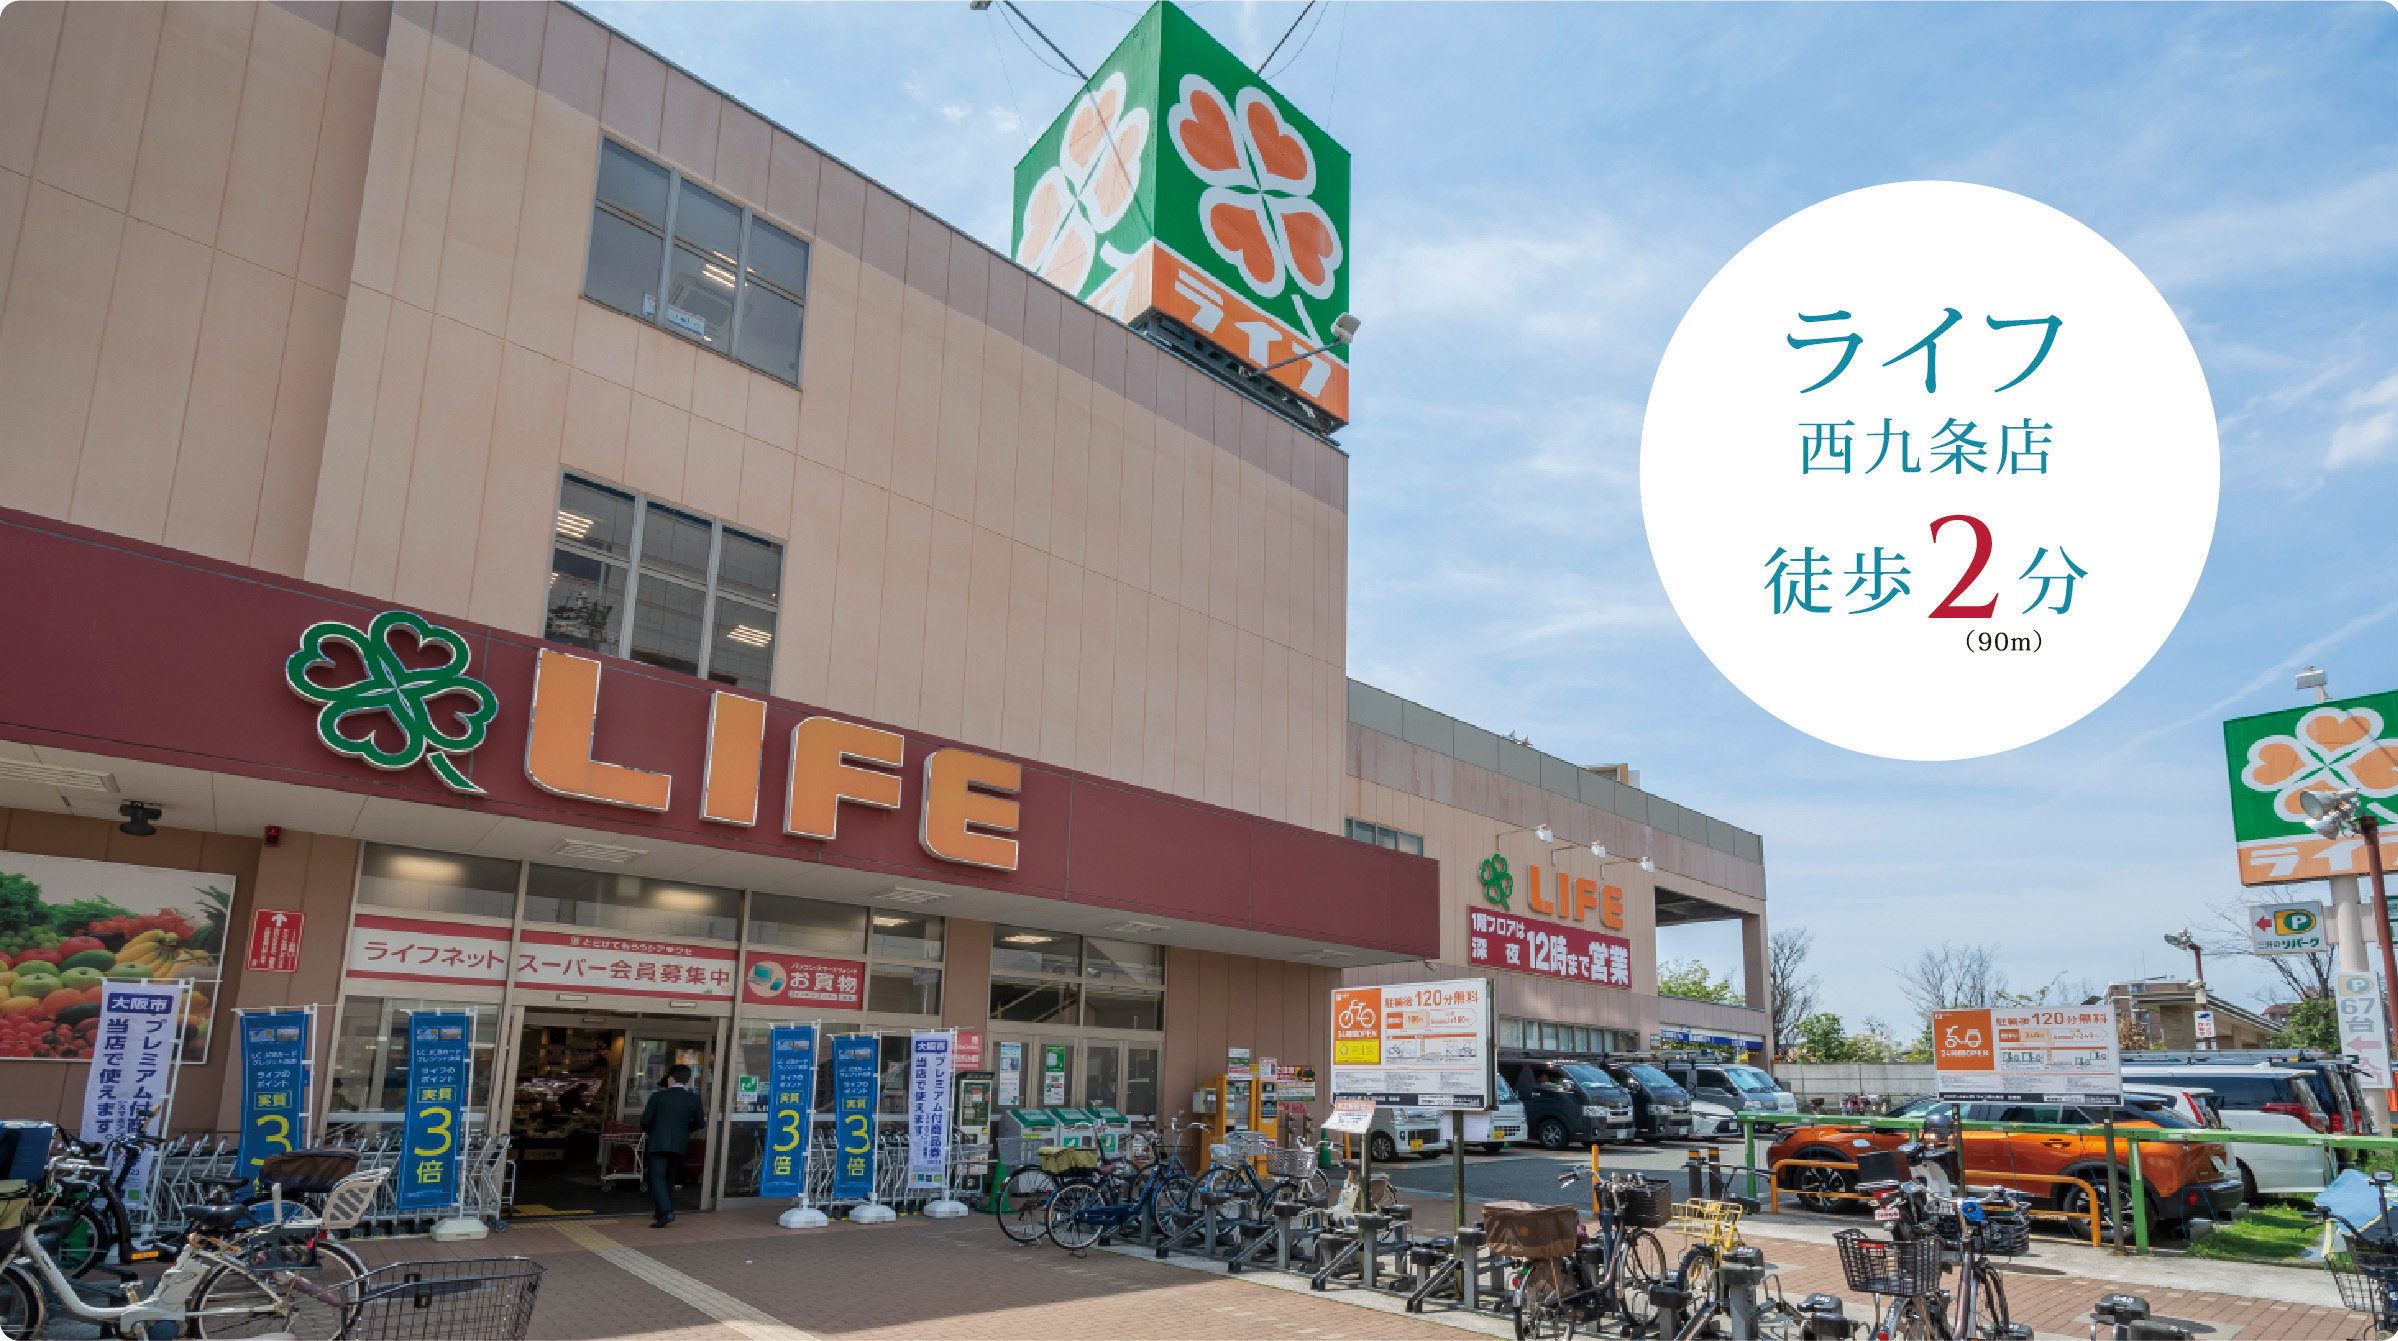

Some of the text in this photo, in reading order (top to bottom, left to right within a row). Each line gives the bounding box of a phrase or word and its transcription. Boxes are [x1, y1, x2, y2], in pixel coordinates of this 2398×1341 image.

[1174, 268, 1332, 400] ライフ
[524, 647, 1022, 870] LIFE
[1528, 864, 1624, 930] LIFE
[363, 940, 731, 987] ライフネット スーパー会員募集中
[790, 971, 858, 994] お買物
[110, 996, 169, 1013] 大阪市
[2340, 997, 2376, 1015] 67
[2345, 1015, 2375, 1033] 台
